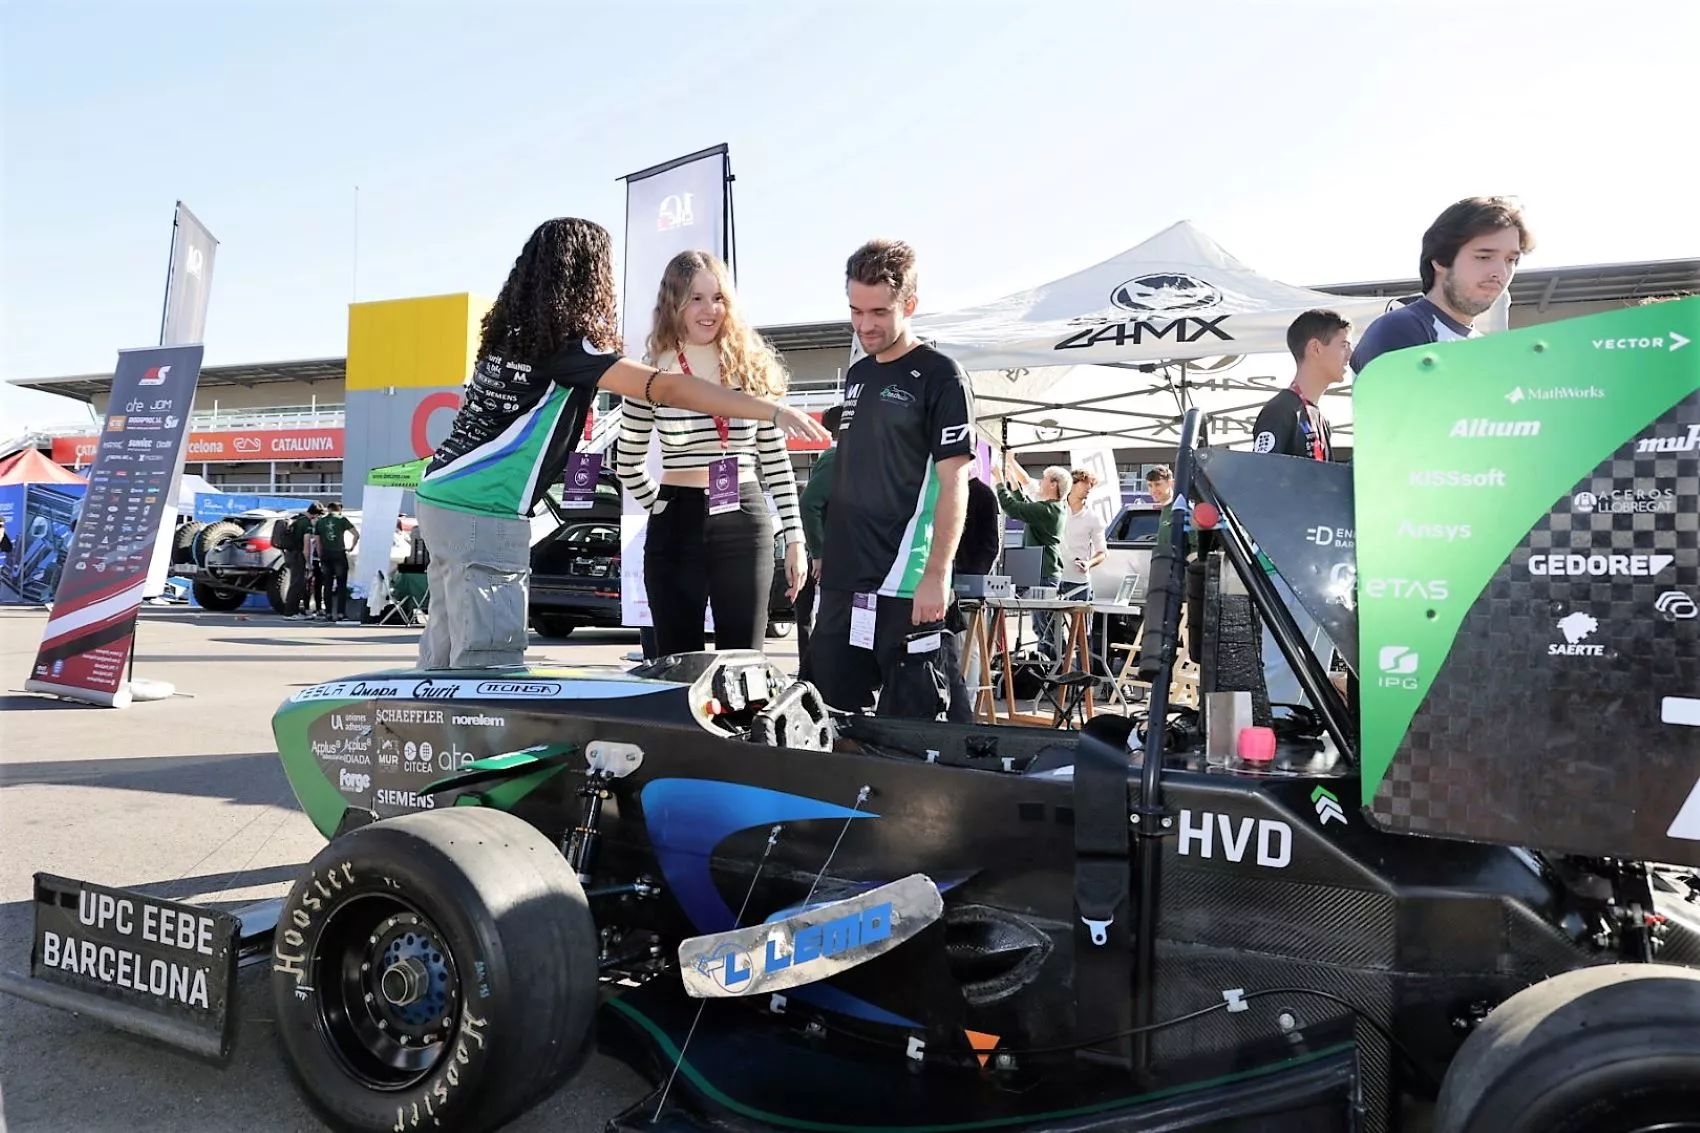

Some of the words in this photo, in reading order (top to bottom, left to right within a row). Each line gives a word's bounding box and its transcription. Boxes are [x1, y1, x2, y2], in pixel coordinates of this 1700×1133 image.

[1592, 338, 1665, 350] VECTOR
[1528, 386, 1606, 401] MathWorks
[189, 438, 224, 454] celona
[271, 436, 334, 452] CATALUNYA
[1407, 468, 1506, 488] KISSsoft
[1598, 488, 1673, 501] ACEROS
[1598, 500, 1672, 513] LLOBREGAT
[1397, 520, 1472, 543] Ansys
[1528, 554, 1649, 576] GEDORE
[412, 679, 460, 698] Gurit
[1378, 677, 1419, 690] IPG
[376, 709, 444, 724] SCHAEFFLER
[452, 714, 505, 727] norelem
[379, 755, 399, 765] MUR
[404, 761, 433, 773] CITCEA
[377, 789, 435, 809] SIEMENS
[1178, 809, 1293, 868] HVD
[79, 889, 134, 936] UPC
[143, 904, 215, 956] EEBE
[273, 861, 355, 985] Hoosier
[764, 900, 893, 974] LEMO
[43, 931, 209, 1009] BARCELONA
[393, 998, 488, 1132] Hoosier
